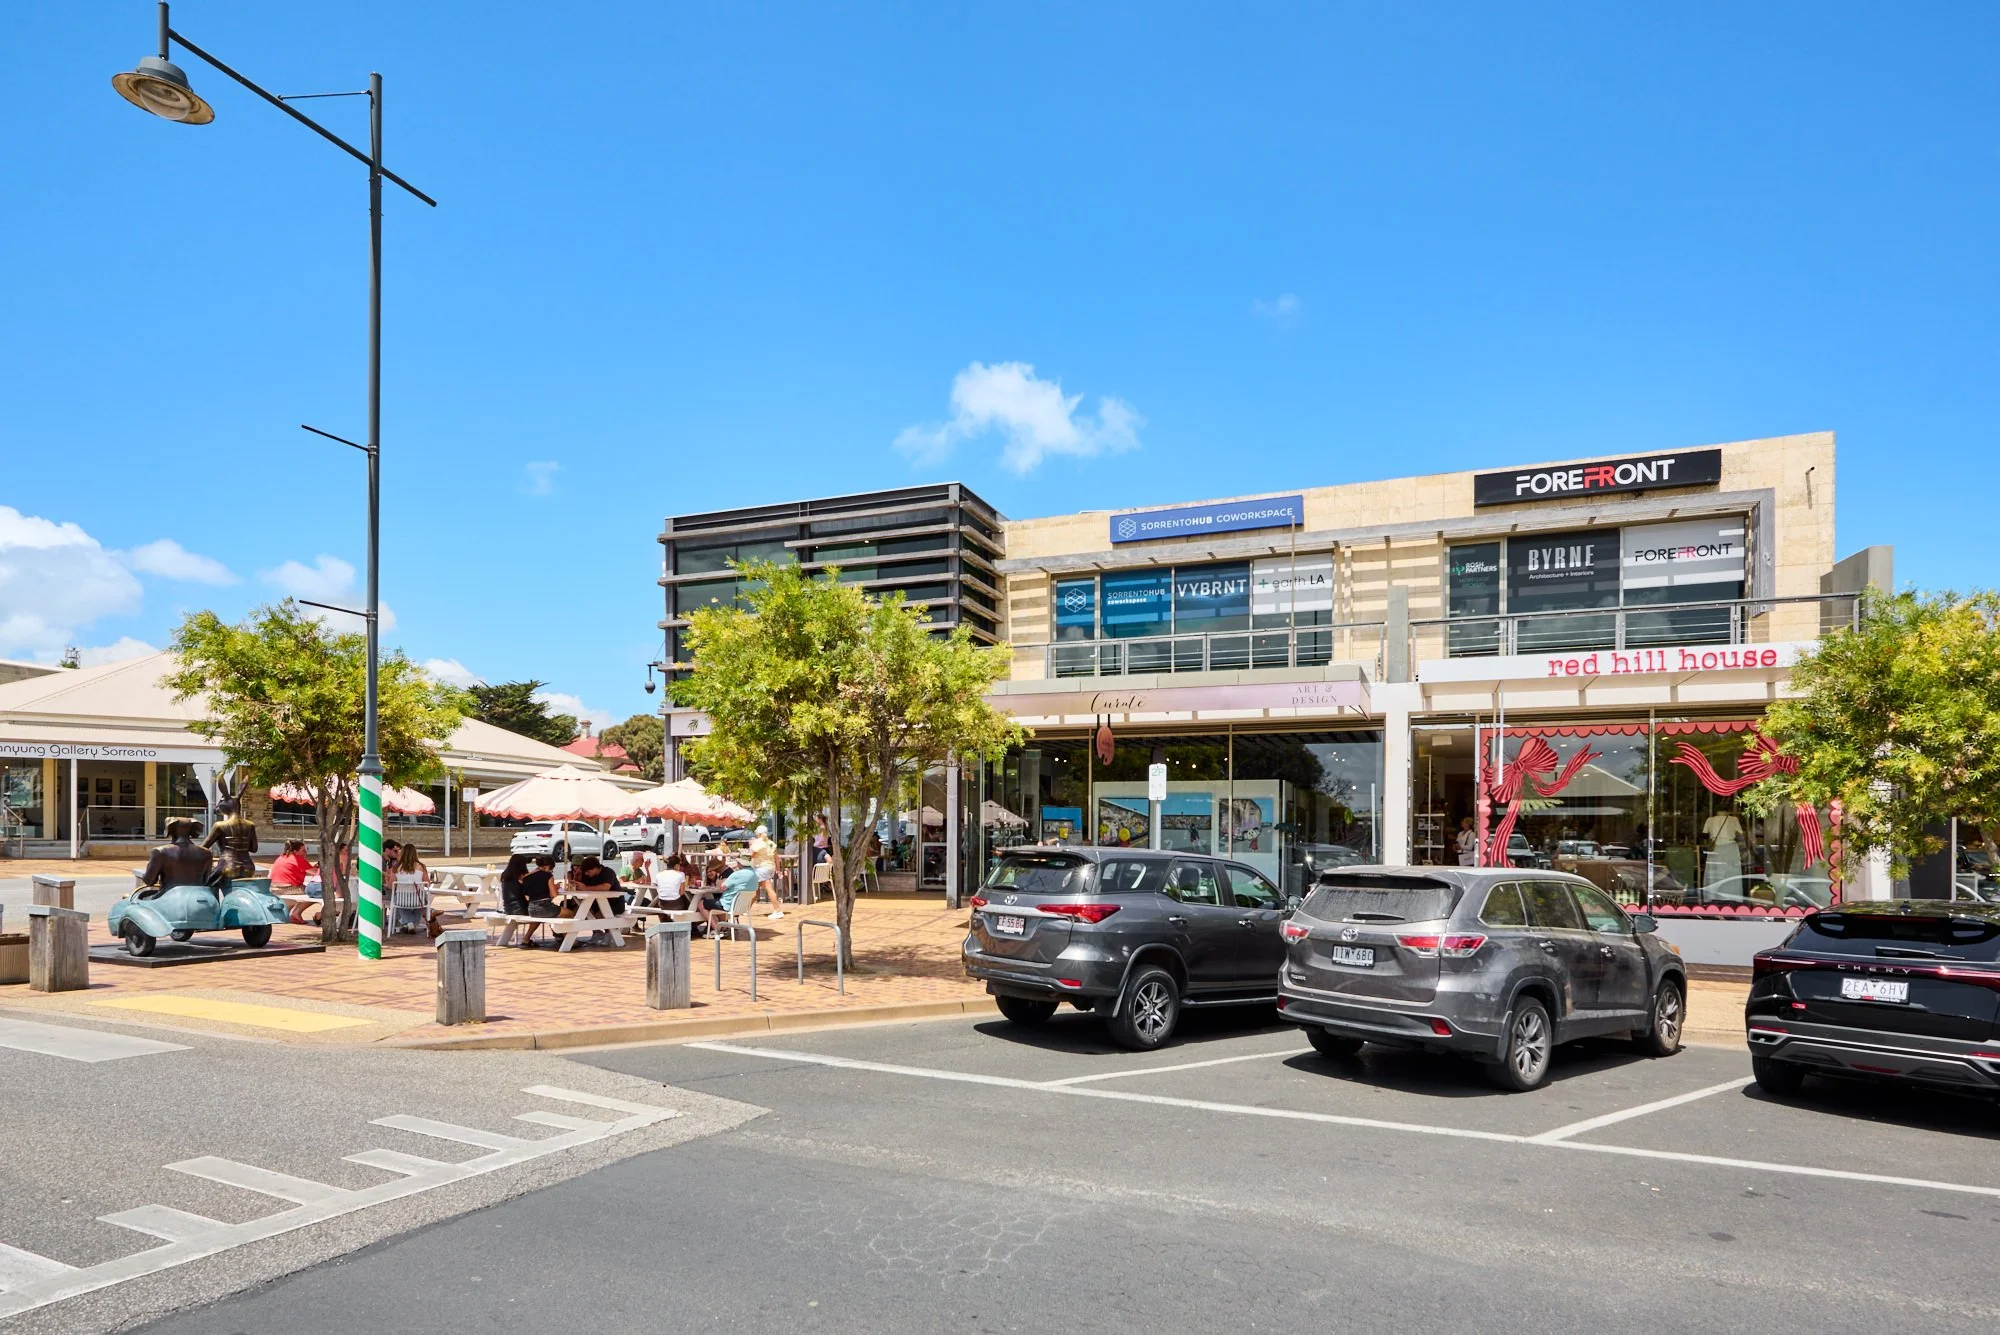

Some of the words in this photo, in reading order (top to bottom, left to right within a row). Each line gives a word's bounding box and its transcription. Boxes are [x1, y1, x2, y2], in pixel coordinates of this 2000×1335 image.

[1516, 459, 1675, 496] FOREFRONT
[1141, 516, 1213, 531] SORRENTOHUB
[1216, 507, 1293, 523] COWORKSPACE
[1528, 544, 1595, 571] BYRNE
[1635, 543, 1733, 562] FOREFRONT
[1310, 574, 1325, 585] LA
[1529, 571, 1564, 580] Architecture
[1107, 588, 1165, 599] SORRENTOHUB
[1177, 579, 1247, 598] VYBRNT
[1548, 653, 1600, 676] red
[1611, 650, 1667, 673] hill
[1678, 648, 1777, 671] house
[1297, 685, 1318, 694] ART
[1292, 695, 1337, 705] DESIGN
[50, 744, 98, 758] Gallery
[102, 746, 157, 757] Sorrento
[1152, 768, 1165, 777] 2P
[1837, 964, 1911, 974] CHERY
